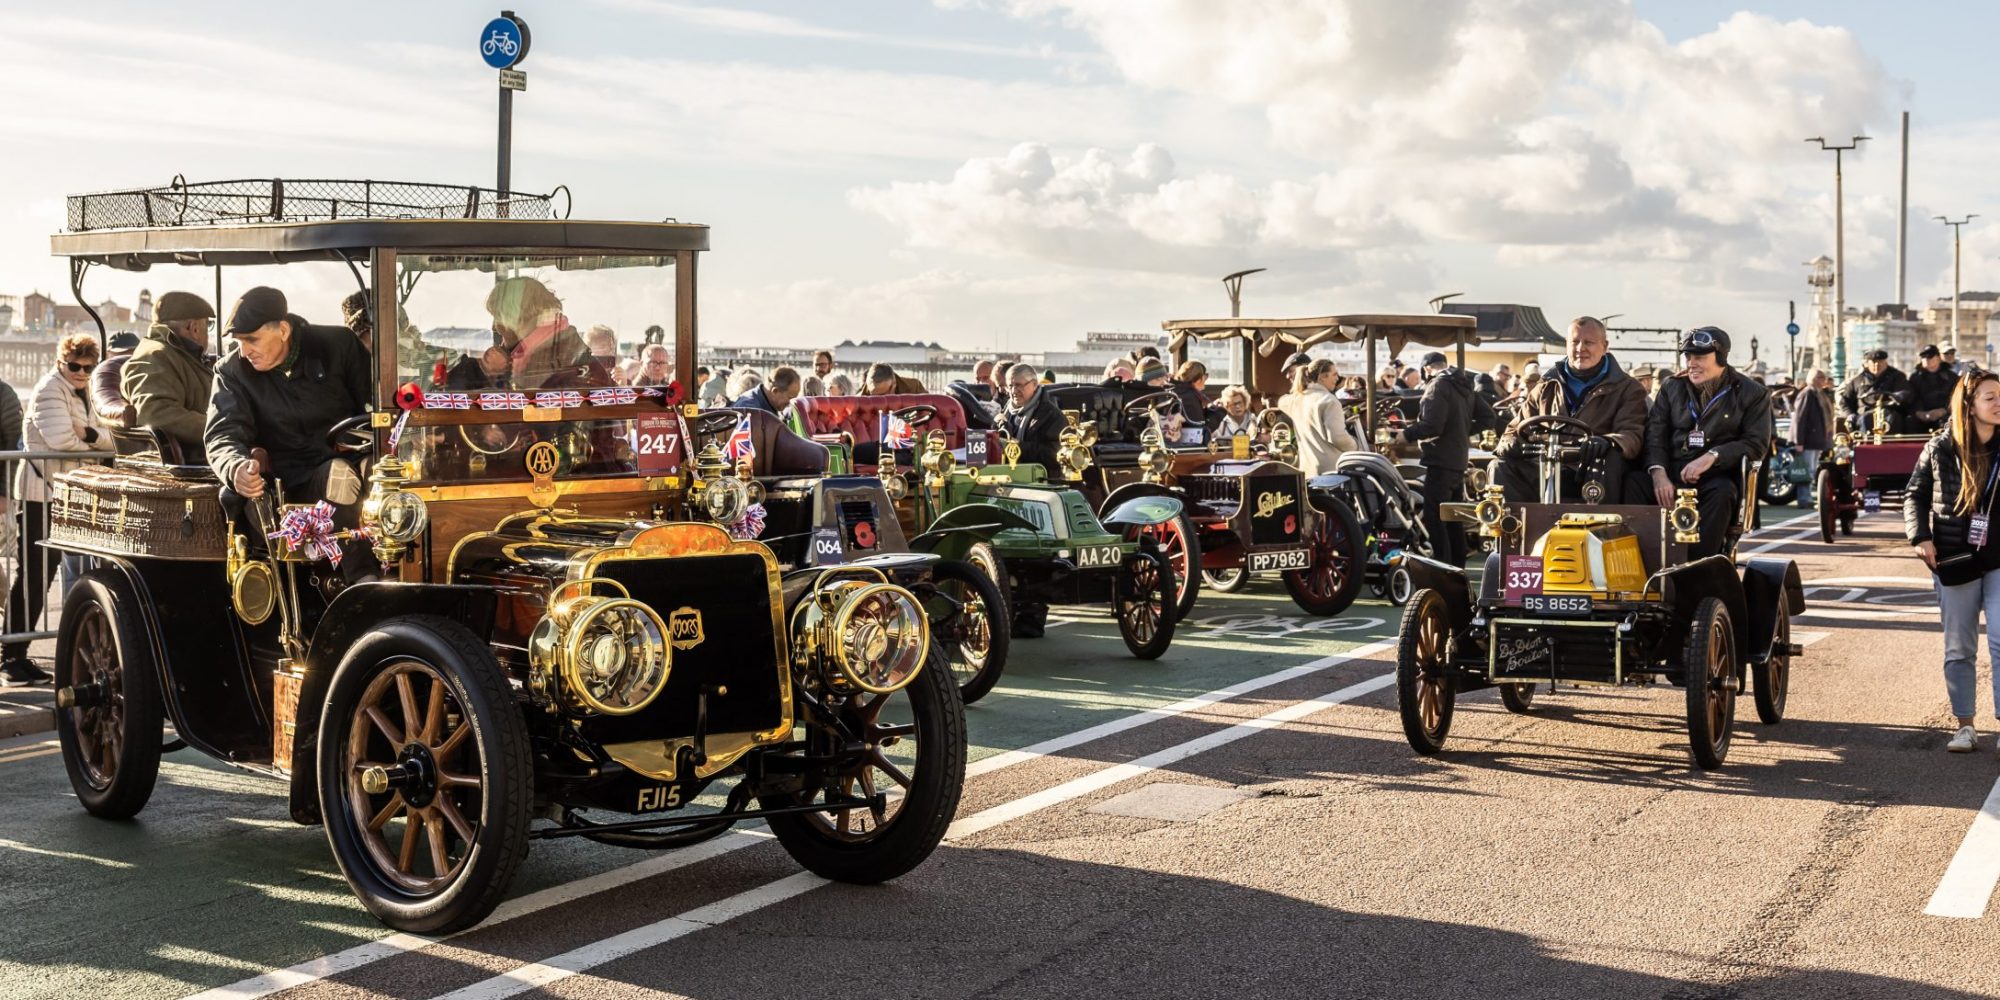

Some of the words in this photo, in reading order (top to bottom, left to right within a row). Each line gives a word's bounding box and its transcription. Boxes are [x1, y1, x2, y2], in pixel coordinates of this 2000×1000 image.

[640, 433, 678, 454] 247
[968, 441, 986, 454] 168
[1253, 491, 1295, 518] Cadillac
[816, 540, 842, 554] 064
[1080, 548, 1099, 566] AA
[1101, 546, 1121, 565] 20
[1253, 552, 1305, 570] PP7962
[1508, 572, 1542, 588] 337
[1525, 597, 1543, 609] BS
[1549, 598, 1588, 610] 8652
[638, 785, 681, 811] FJ15
